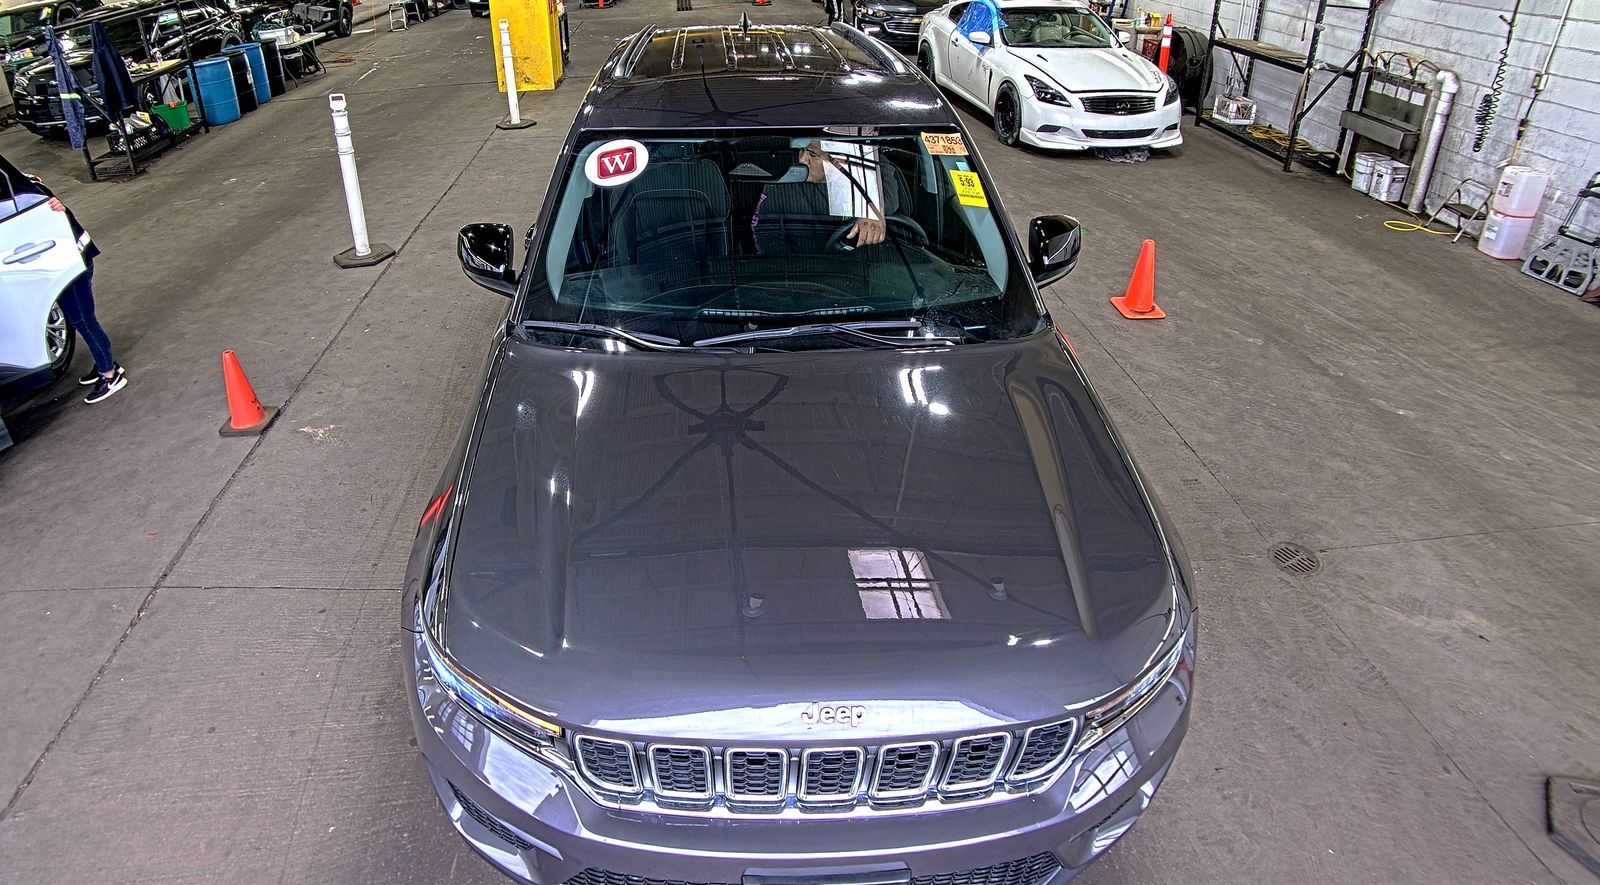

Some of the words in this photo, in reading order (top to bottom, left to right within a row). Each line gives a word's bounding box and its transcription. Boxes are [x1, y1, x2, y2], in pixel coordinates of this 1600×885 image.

[924, 135, 963, 145] 4371853
[601, 151, 632, 174] W
[801, 701, 867, 728] Jeep
